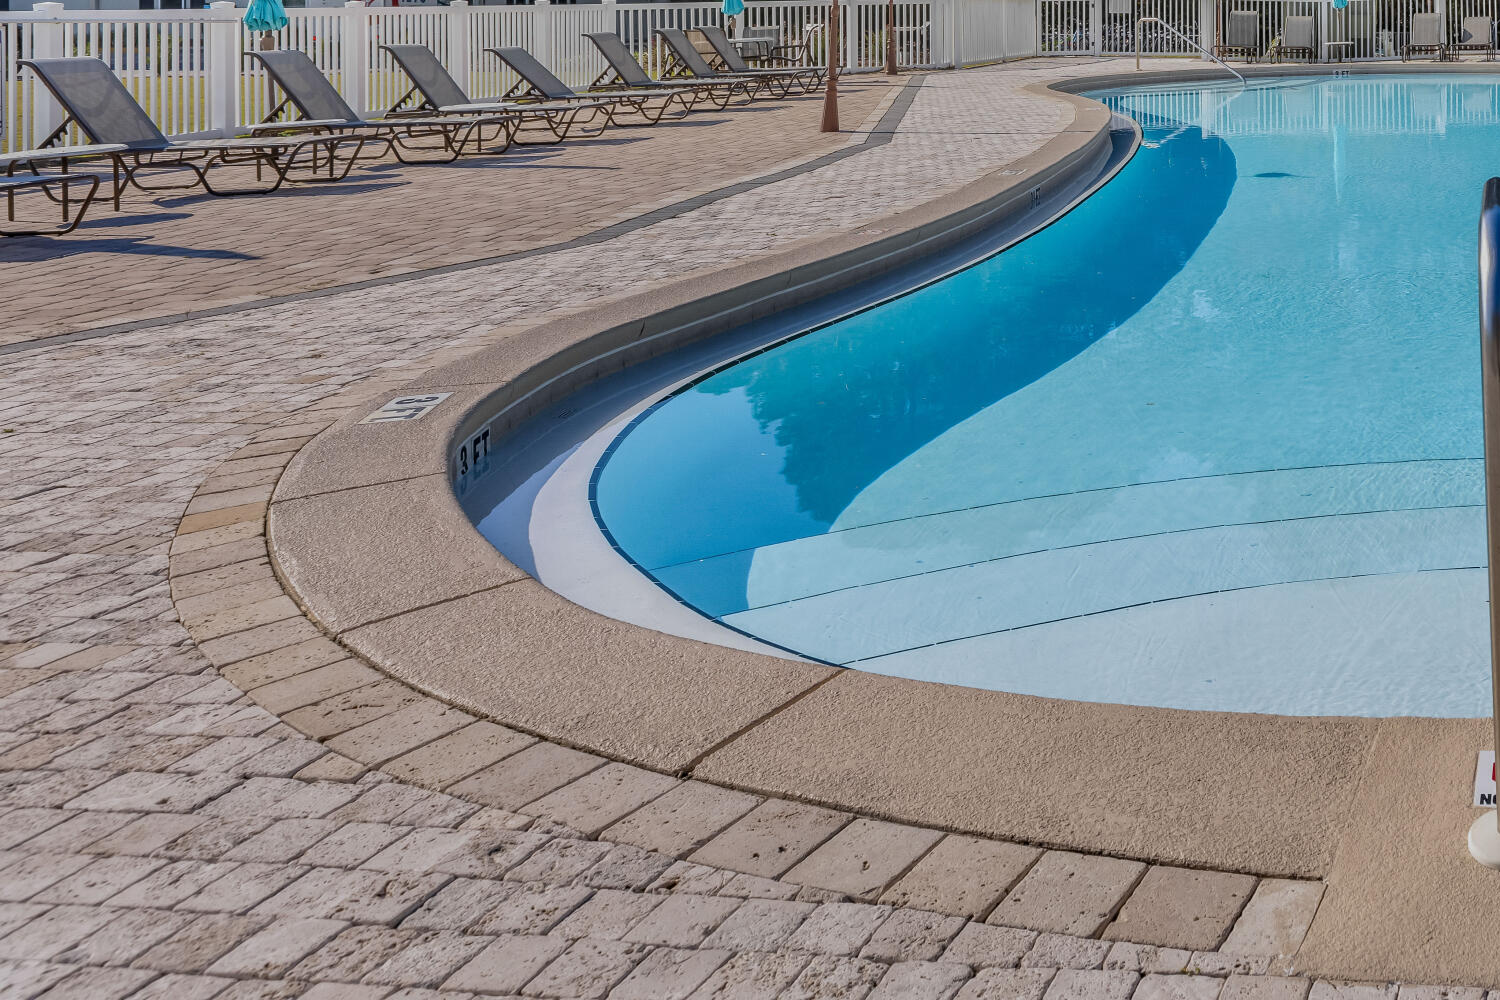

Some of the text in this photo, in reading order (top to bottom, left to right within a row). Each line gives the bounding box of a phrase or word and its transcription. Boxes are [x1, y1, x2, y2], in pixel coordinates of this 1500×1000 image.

[370, 396, 439, 421] 3 FT
[460, 428, 490, 475] 3 FT
